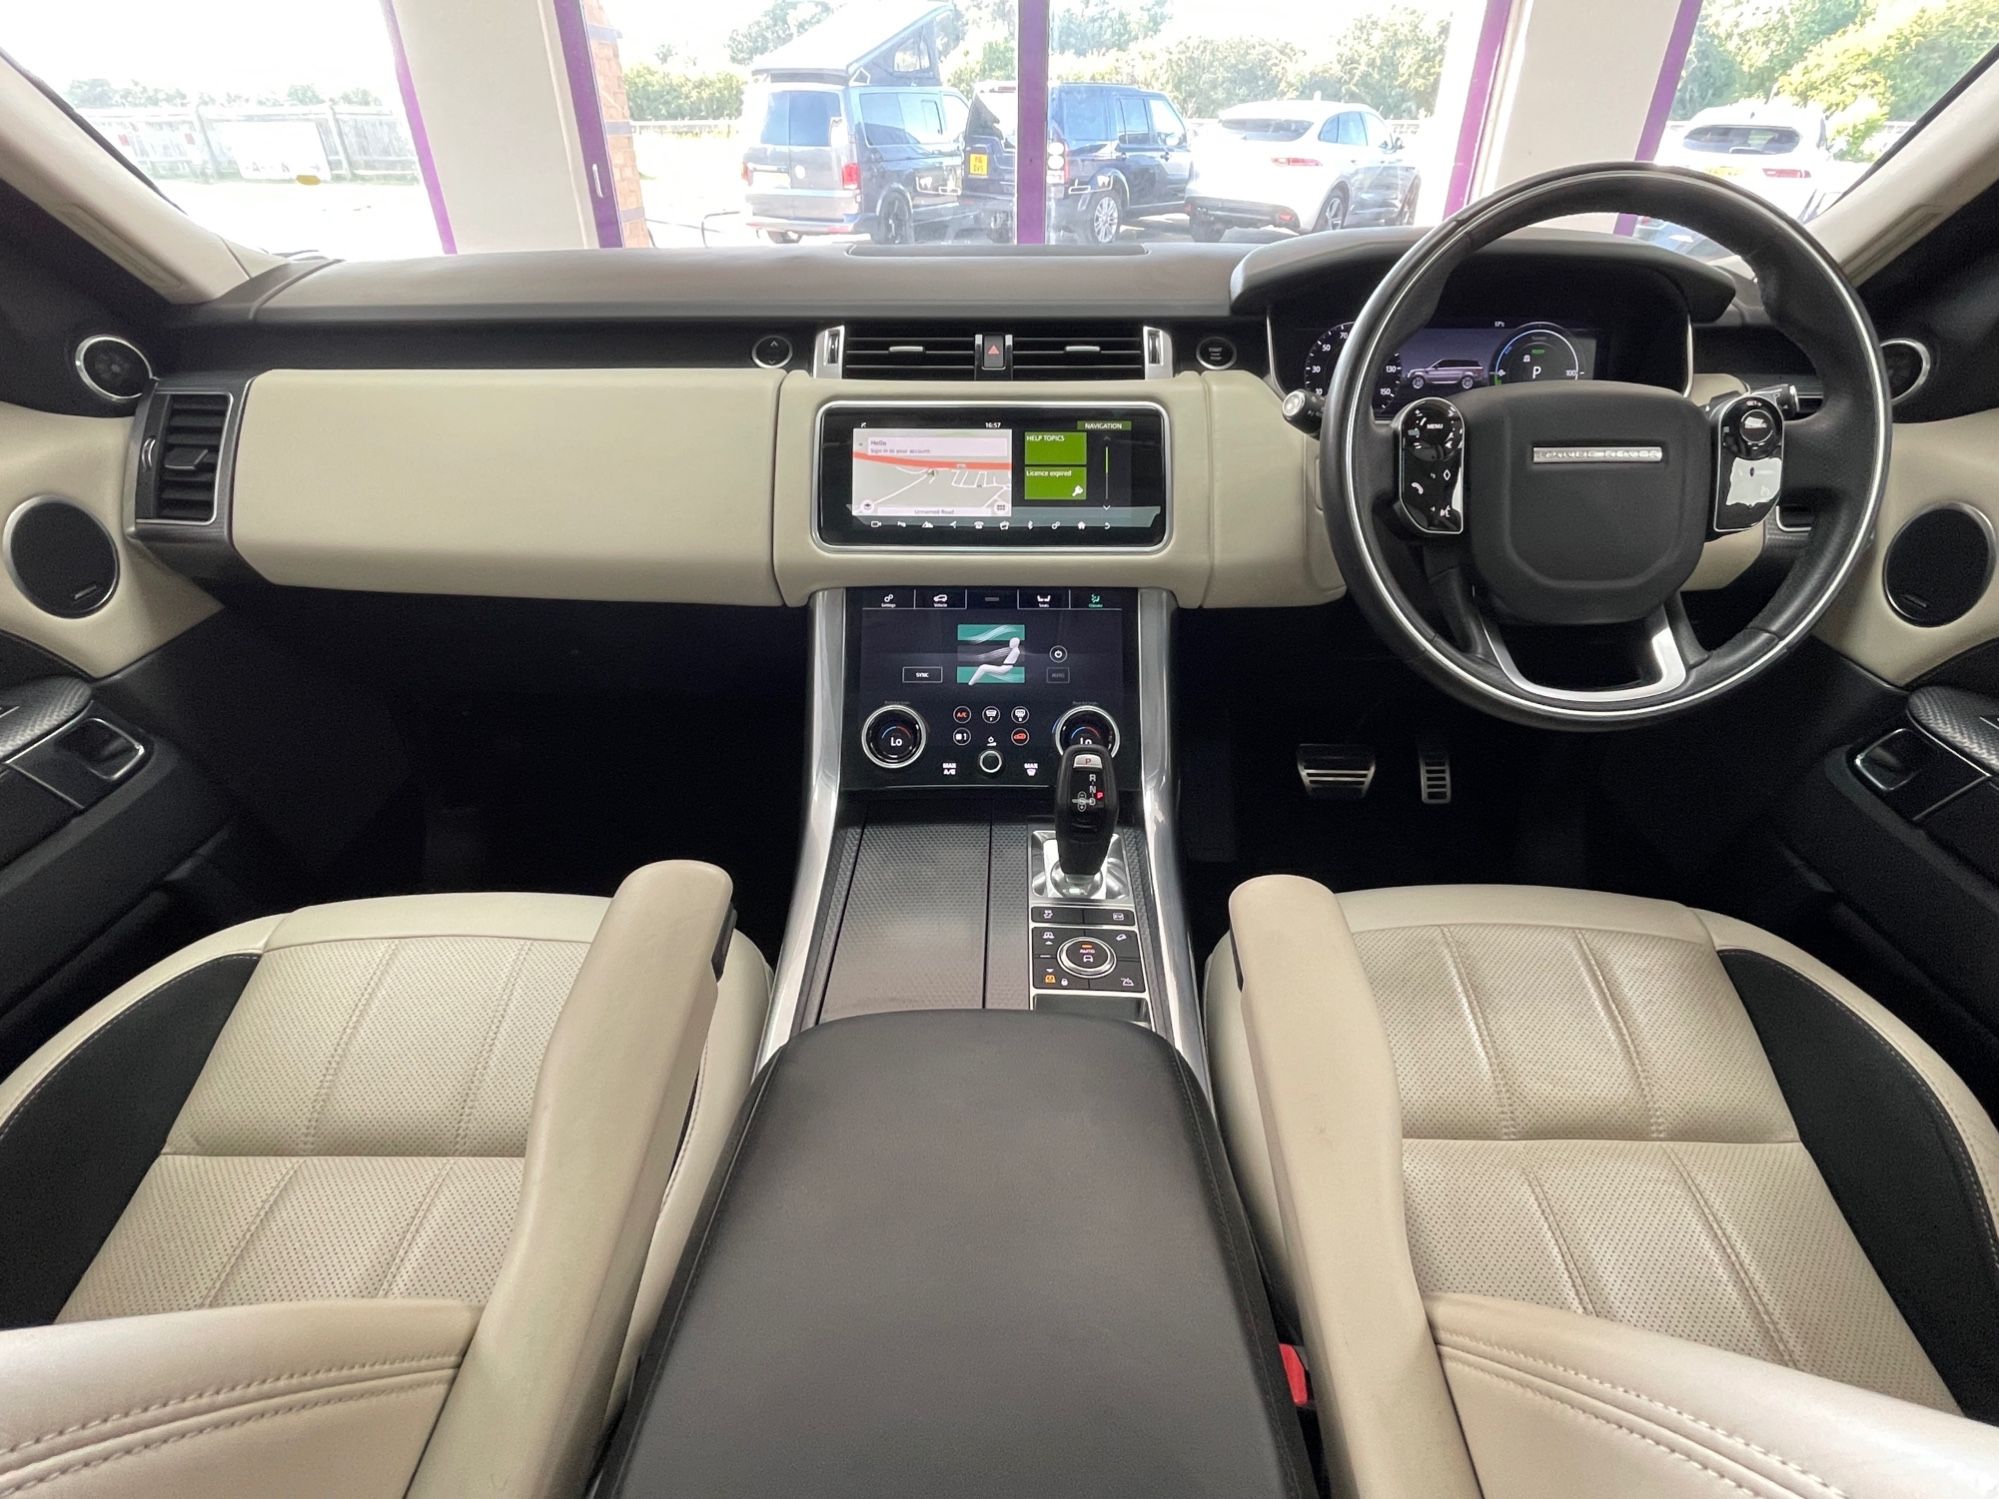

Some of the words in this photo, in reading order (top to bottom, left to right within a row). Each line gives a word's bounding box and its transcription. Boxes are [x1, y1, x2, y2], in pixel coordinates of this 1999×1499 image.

[1532, 366, 1541, 379] P
[1049, 470, 1072, 478] expired
[890, 737, 903, 747] Lo
[1089, 774, 1096, 782] R
